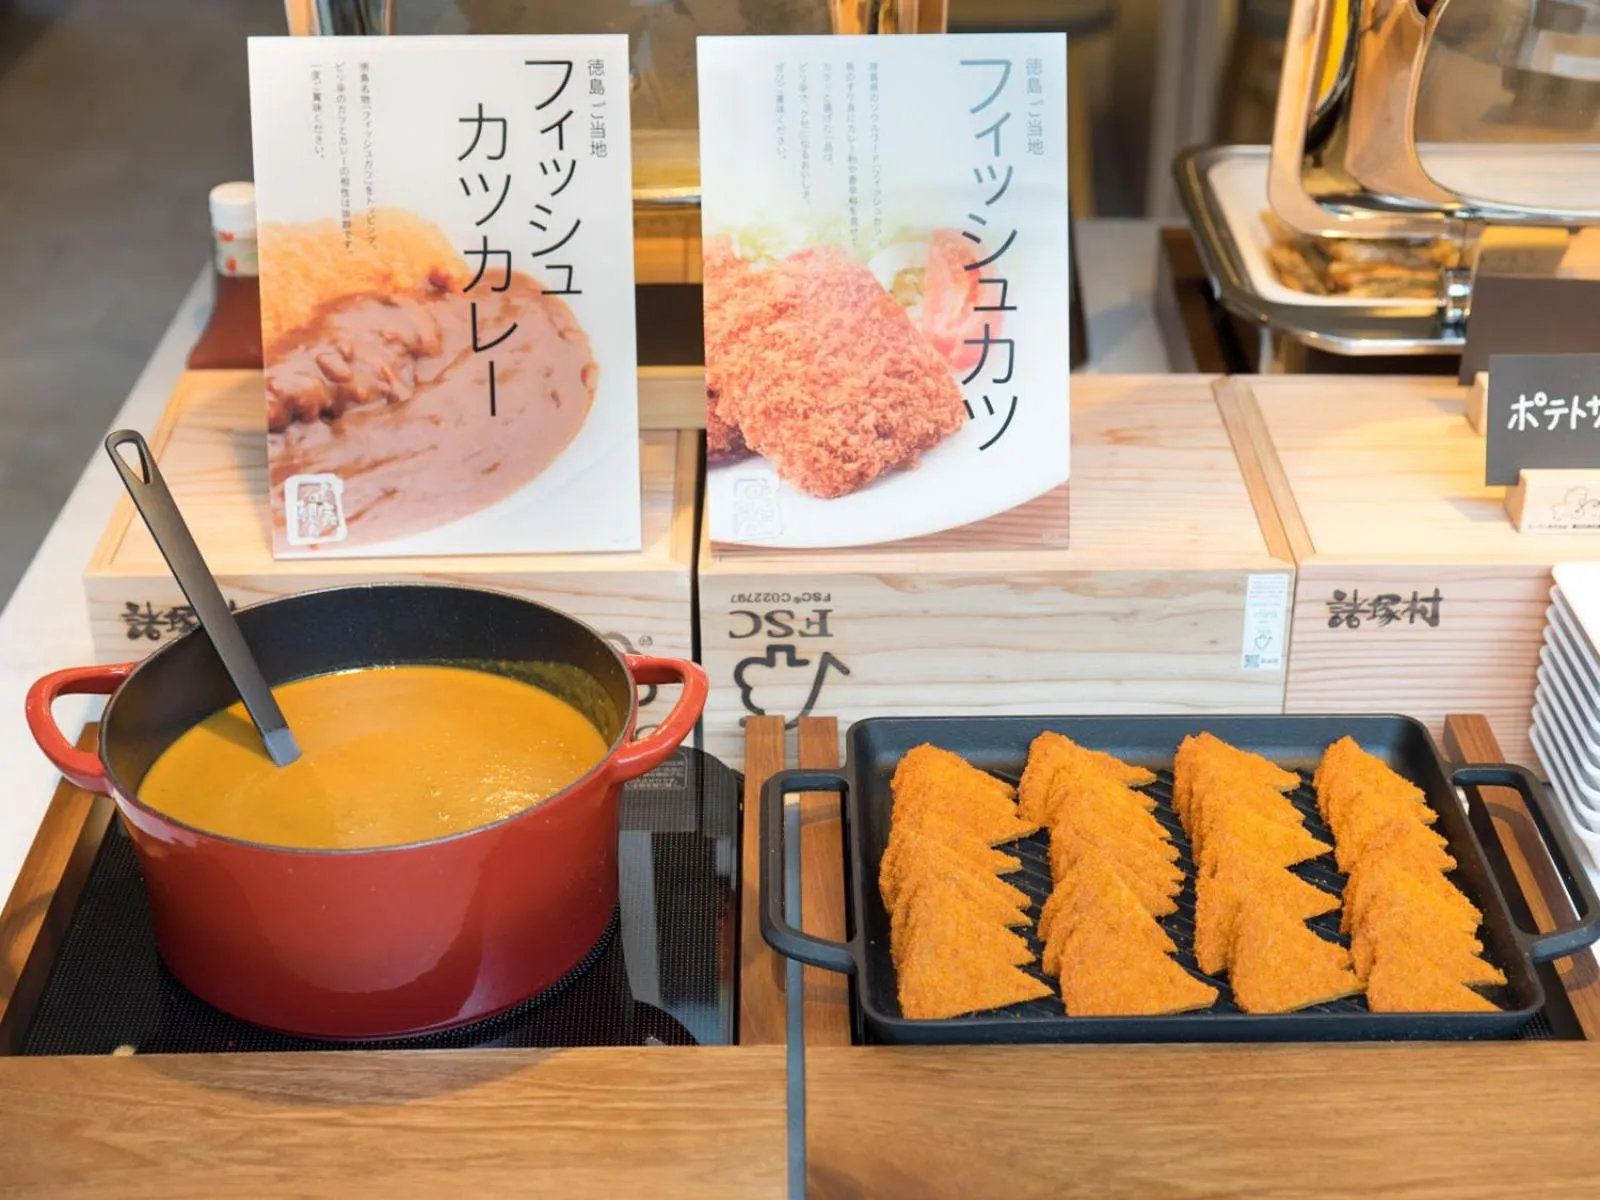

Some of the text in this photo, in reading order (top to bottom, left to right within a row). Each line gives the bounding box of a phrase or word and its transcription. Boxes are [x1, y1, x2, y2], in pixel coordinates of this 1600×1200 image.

[457, 102, 519, 417] カツカレー
[524, 60, 583, 296] フィッシュ
[959, 60, 1019, 451] フィッシュカツ
[728, 609, 834, 639] FSC
[1325, 587, 1444, 629] 諸塚村
